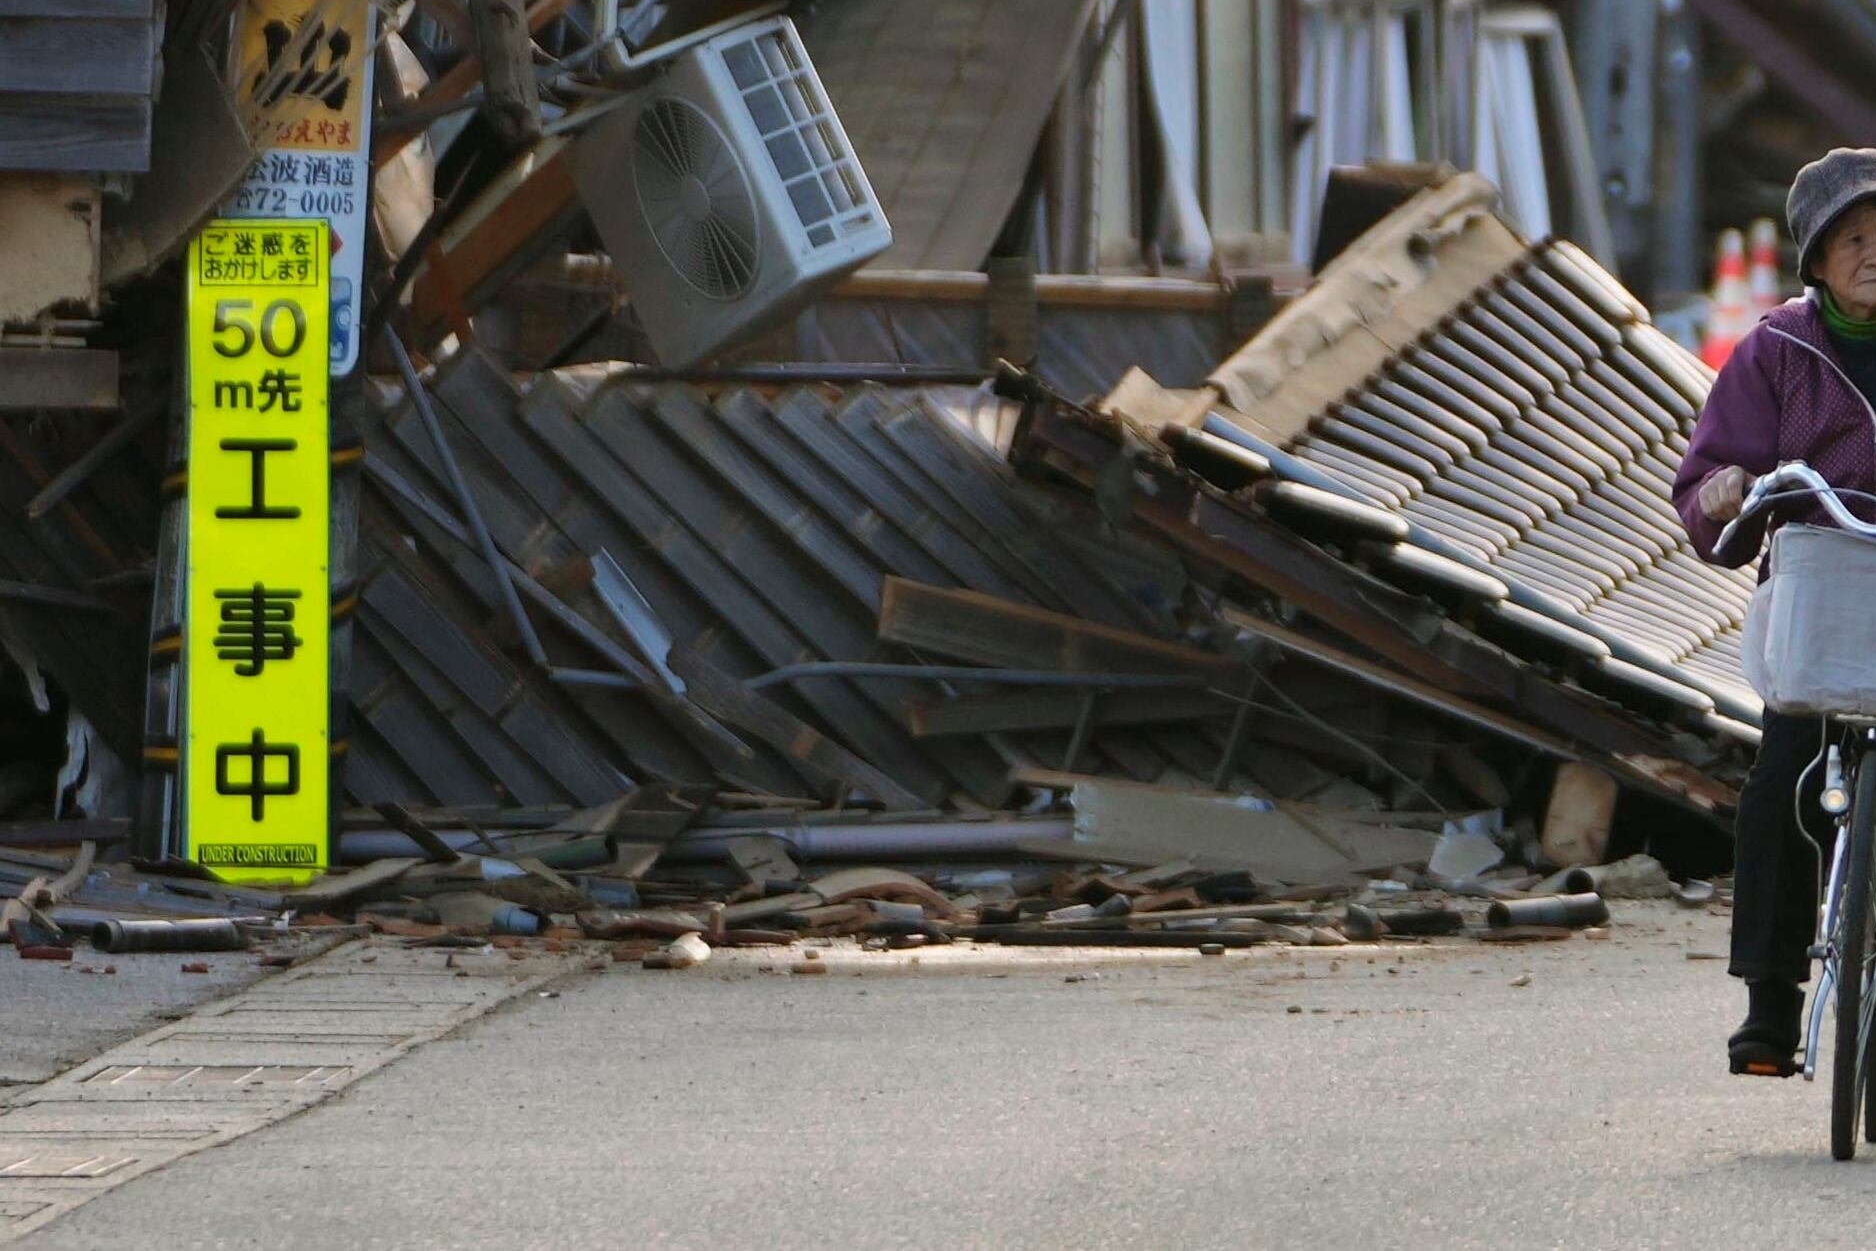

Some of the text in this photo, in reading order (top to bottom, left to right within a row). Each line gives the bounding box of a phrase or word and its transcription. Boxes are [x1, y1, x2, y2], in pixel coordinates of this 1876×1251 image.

[204, 232, 312, 256] ご迷惑を
[204, 257, 312, 281] おかけします
[212, 298, 307, 358] 50
[214, 368, 303, 413] m先
[212, 437, 304, 823] 工事中
[200, 845, 315, 864] UNDER CONSTRUCTION
